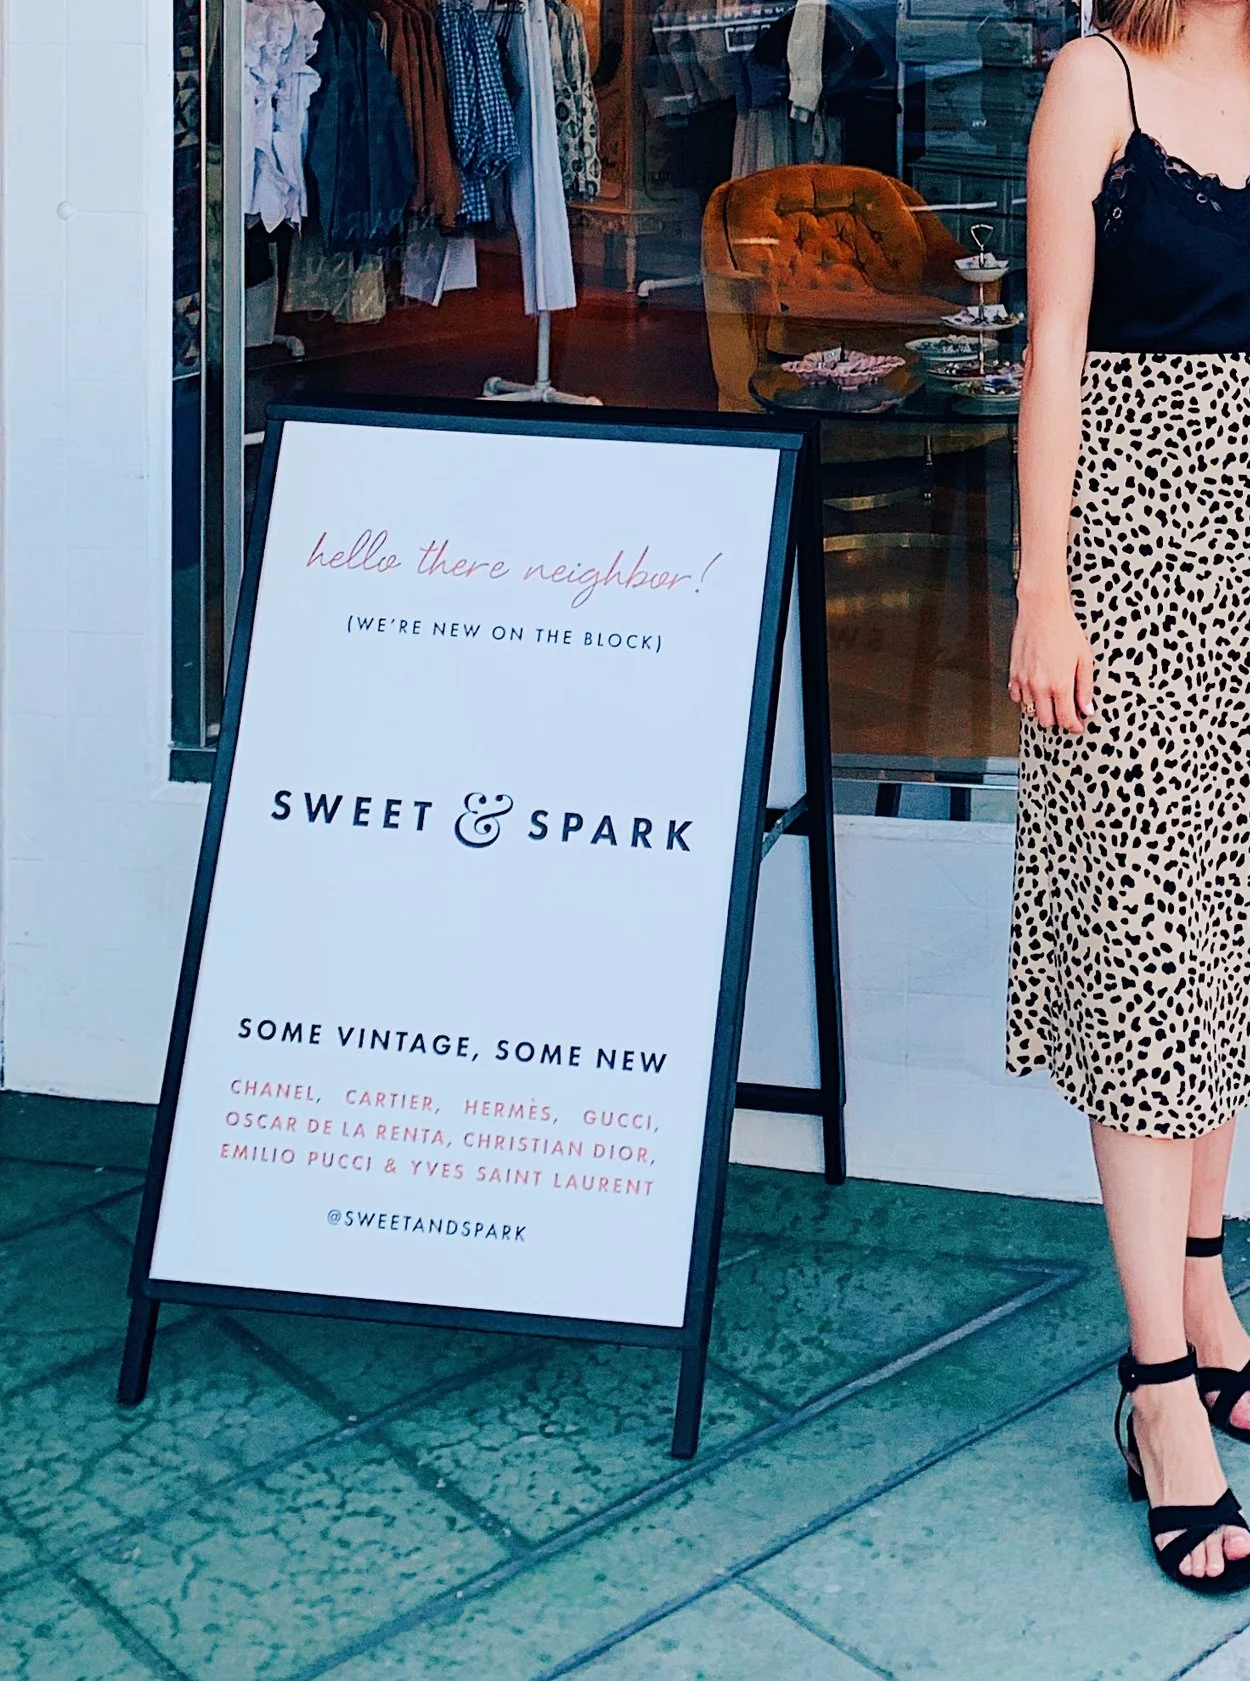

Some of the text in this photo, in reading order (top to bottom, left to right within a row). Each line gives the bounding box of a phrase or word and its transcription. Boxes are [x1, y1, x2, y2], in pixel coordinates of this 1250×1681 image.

[306, 528, 723, 609] hello there neighbor!
[347, 614, 661, 654] (WE'RE NEW ON THE BLOCK)
[270, 789, 693, 852] SWEET & SPARK
[237, 1017, 668, 1074] SOME VINTAGE, SOME NEW
[230, 1079, 321, 1104] CHANEL,
[345, 1089, 440, 1115] CARTIER,
[583, 1109, 659, 1133] GUCCI,
[225, 1111, 655, 1166] OSCAR DE LA RENTA, CHRISTIAN DIOR,
[220, 1143, 654, 1197] EMILIO PUCCI & YVES SAINT LAURENT
[327, 1209, 526, 1241] @SWEETANDSPARK
